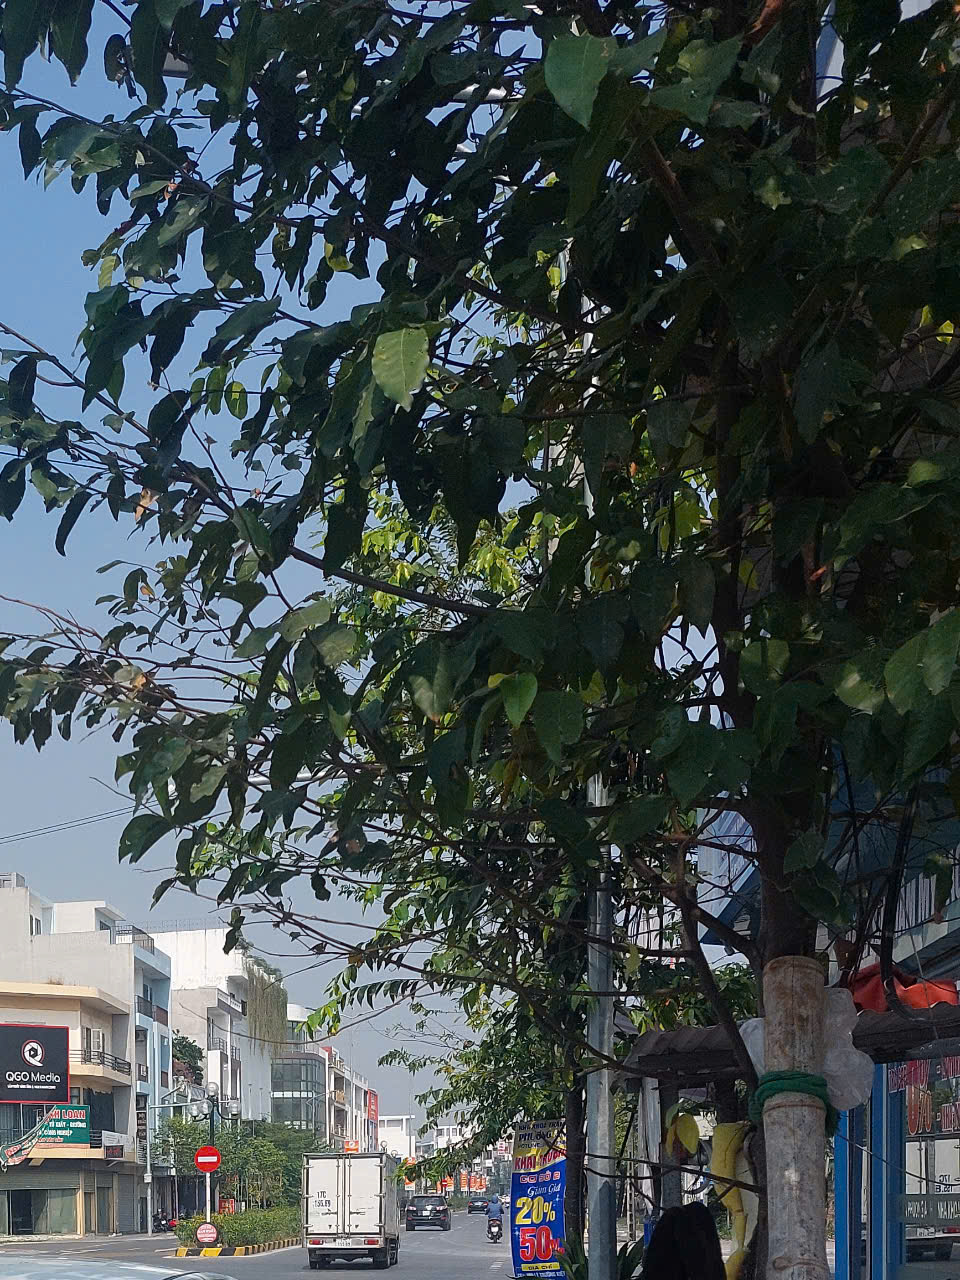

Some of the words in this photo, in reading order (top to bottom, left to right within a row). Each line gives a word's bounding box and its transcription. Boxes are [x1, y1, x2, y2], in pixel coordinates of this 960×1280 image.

[6, 1071, 30, 1082] QGO
[31, 1071, 61, 1083] Media
[62, 1110, 86, 1120] LOAN
[316, 1191, 326, 1199] 17C
[515, 1196, 556, 1225] 20%
[520, 1225, 565, 1261] 50%
